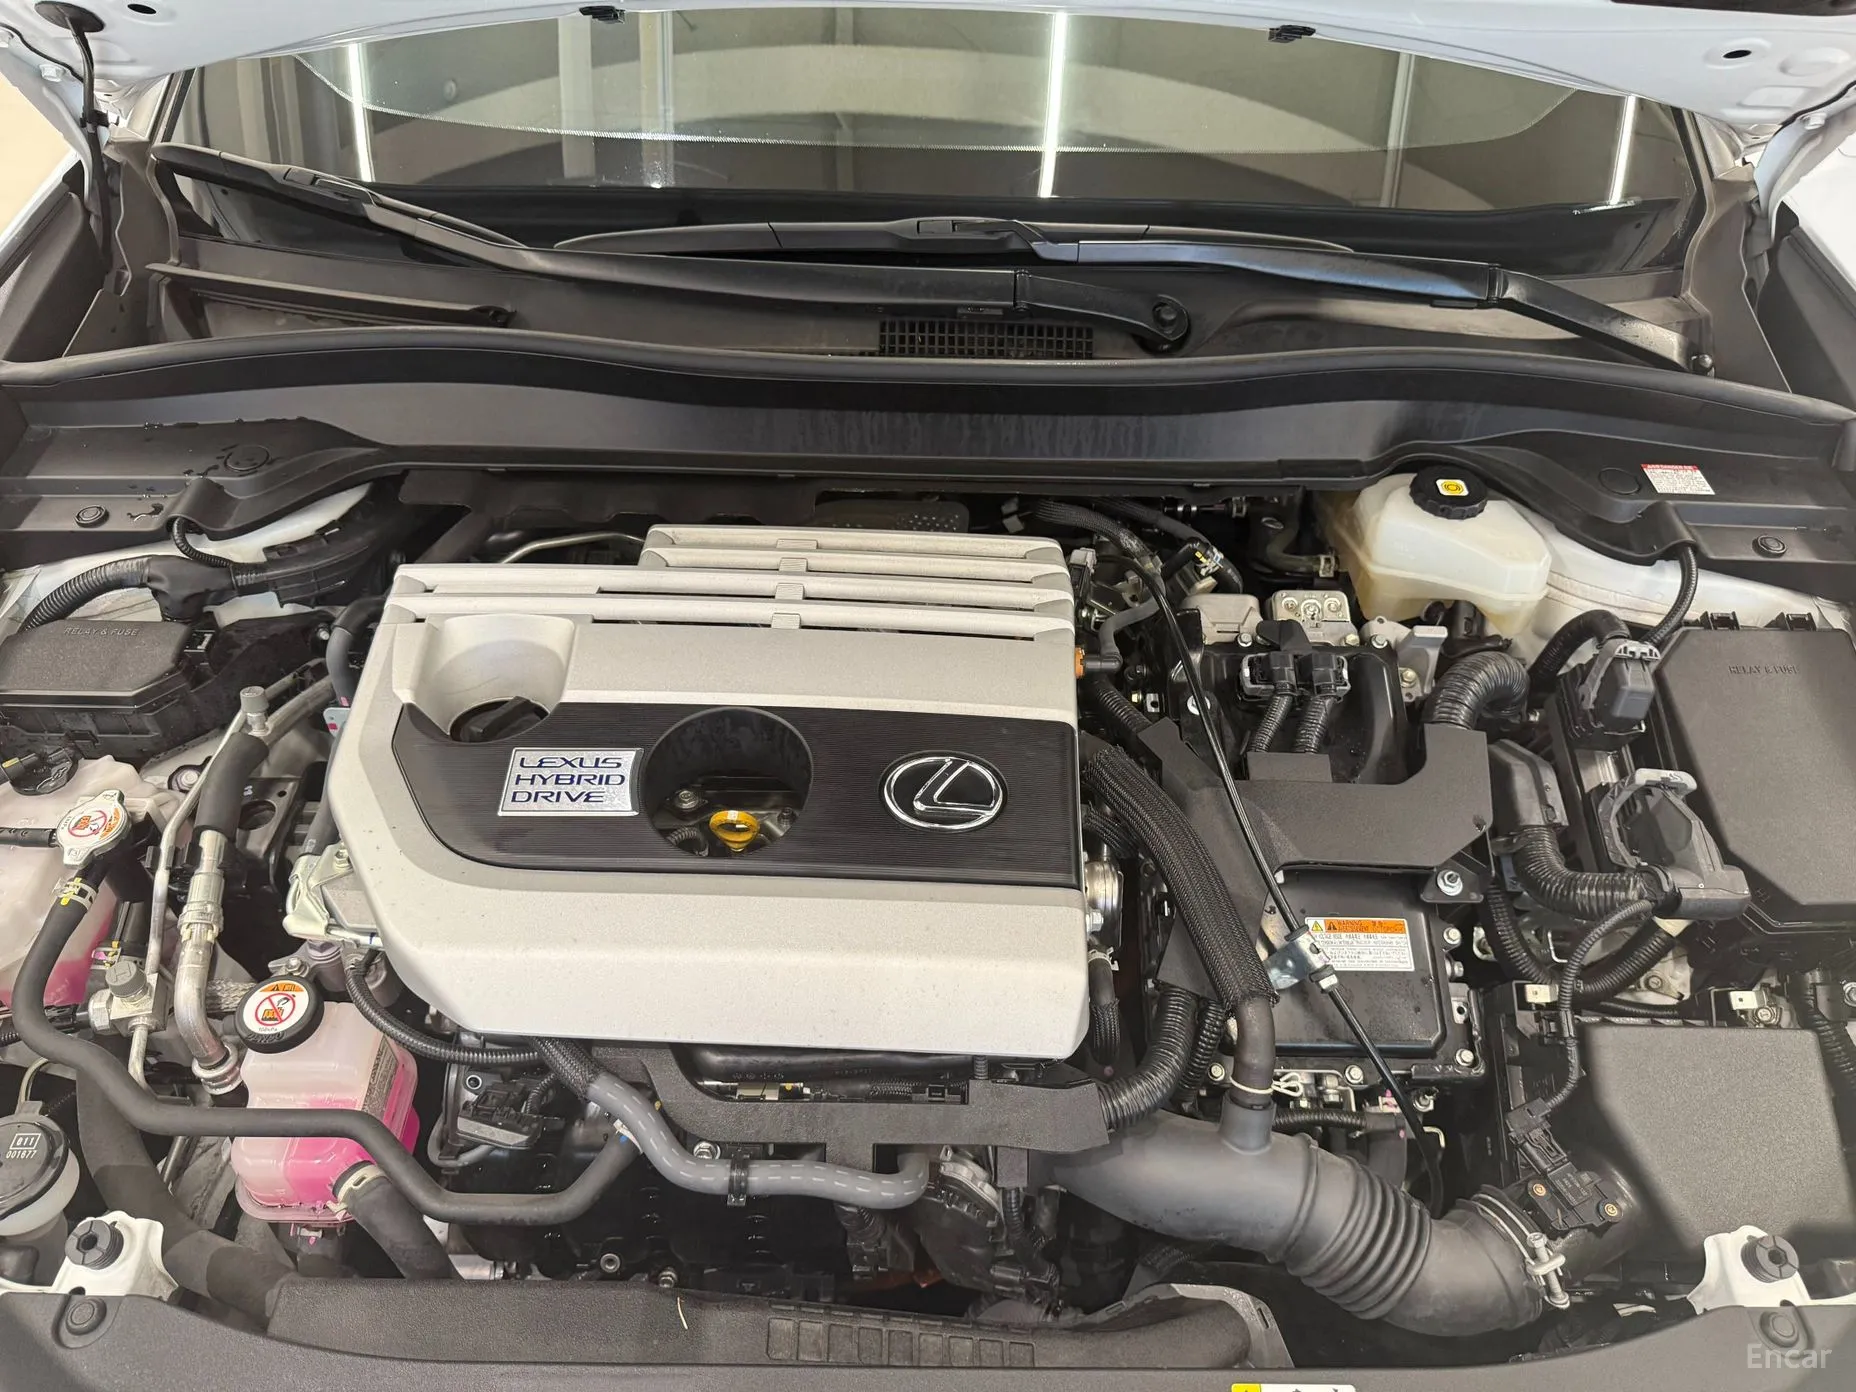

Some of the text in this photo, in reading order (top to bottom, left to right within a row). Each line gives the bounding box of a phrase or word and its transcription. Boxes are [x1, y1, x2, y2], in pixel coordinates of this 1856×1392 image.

[64, 627, 98, 636] RELAY
[110, 627, 138, 636] FUSE
[519, 757, 622, 769] LEXUS
[515, 773, 626, 786] HYBRID
[511, 790, 606, 803] DRIVE
[5, 1149, 38, 1159] 001677
